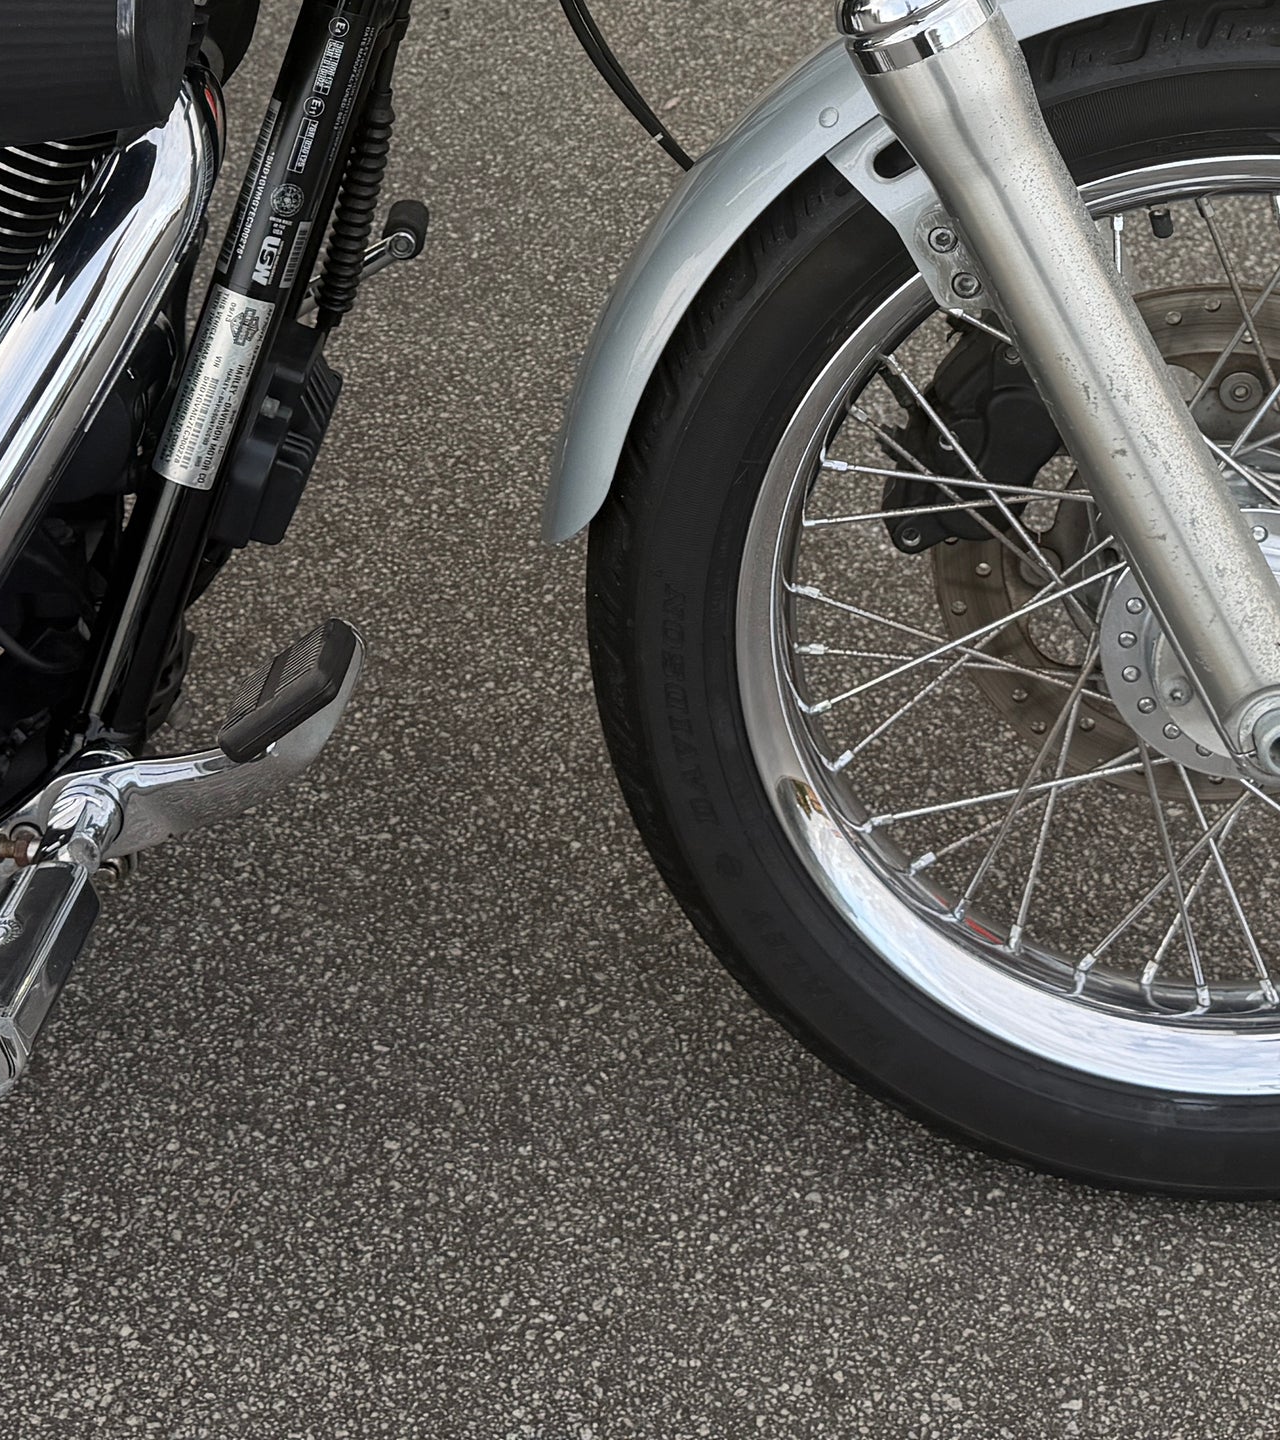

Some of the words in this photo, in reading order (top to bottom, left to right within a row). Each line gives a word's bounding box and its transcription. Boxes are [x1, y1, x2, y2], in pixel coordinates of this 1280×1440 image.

[308, 98, 321, 115] E11
[250, 233, 281, 286] USW
[218, 292, 229, 309] THIS
[224, 301, 236, 322] 09/13
[206, 311, 222, 341] VEHICLE
[200, 342, 211, 360] WAS
[212, 354, 222, 368] VIN
[201, 443, 217, 471] MOTOR
[196, 472, 207, 484] CO
